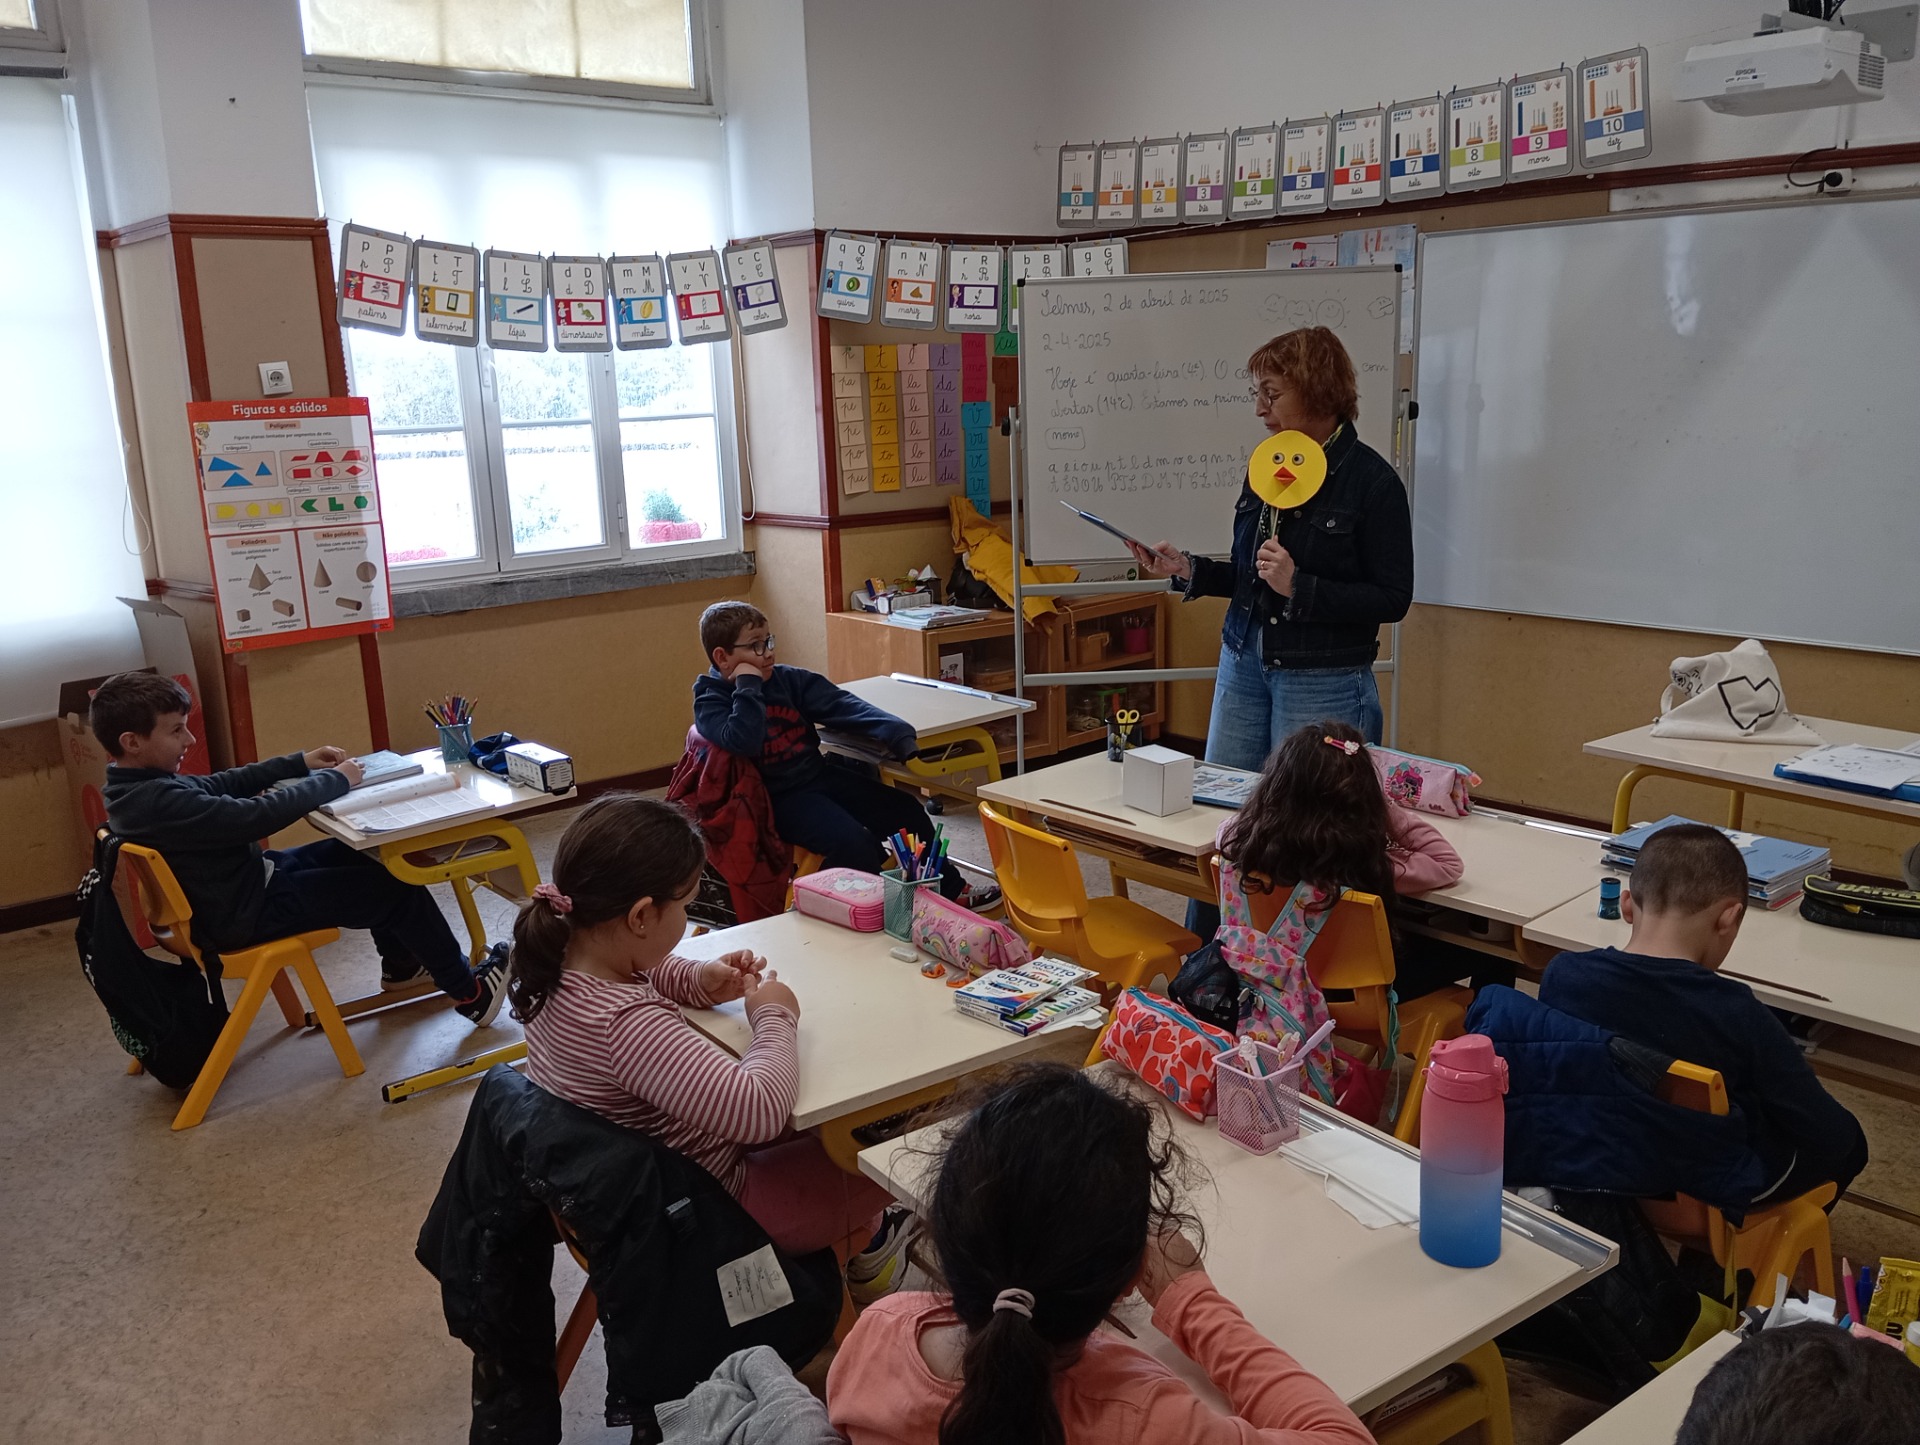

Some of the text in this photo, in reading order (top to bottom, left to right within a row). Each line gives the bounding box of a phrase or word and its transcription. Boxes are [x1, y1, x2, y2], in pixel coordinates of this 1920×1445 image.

[1605, 118, 1622, 133] 10
[1535, 137, 1544, 149] 9
[1470, 149, 1479, 161] 8
[1410, 160, 1418, 172] 7
[1354, 169, 1361, 181] 6
[1250, 182, 1258, 194] 4
[1301, 177, 1308, 188] 5
[1074, 194, 1080, 205] 0
[1115, 194, 1119, 204] 1
[1156, 190, 1162, 201] 2
[1201, 188, 1207, 200] 3
[361, 241, 394, 255] p P
[840, 244, 866, 256] q Q
[432, 253, 462, 267] t T
[738, 252, 760, 265] c C
[901, 251, 927, 261] n N
[963, 256, 988, 265] r R
[1024, 255, 1050, 265] b B
[1085, 248, 1112, 263] g G
[503, 261, 530, 276] l L
[565, 266, 591, 278] d D
[623, 266, 651, 277] m M
[682, 261, 705, 274] v V
[1103, 293, 1112, 312] 2
[1119, 295, 1132, 311] de
[1140, 289, 1175, 308] abril
[1180, 289, 1192, 305] de
[1199, 289, 1229, 304] 2025
[358, 306, 387, 320] patins
[425, 316, 467, 333] telemóvel
[508, 325, 526, 340] lápis
[561, 329, 604, 339] dinossauro
[842, 347, 855, 369] p
[875, 345, 888, 369] t
[908, 345, 915, 365] l
[937, 347, 950, 367] d
[839, 375, 857, 393] pa
[873, 376, 892, 391] ta
[907, 374, 922, 388] la
[935, 374, 957, 392] da
[1045, 366, 1077, 398] Hoje
[1214, 358, 1228, 380] O
[232, 404, 276, 418] Figuras
[289, 402, 328, 414] sólidos
[841, 402, 857, 418] pe
[875, 401, 891, 414] te
[909, 397, 920, 412] le
[937, 399, 953, 413] de
[968, 407, 984, 424] v
[1052, 431, 1080, 441] nome
[845, 448, 865, 467] po
[879, 450, 894, 461] to
[910, 442, 926, 459] lo
[937, 443, 957, 459] do
[880, 474, 897, 485] tu
[911, 466, 927, 482] lu
[939, 466, 958, 480] du
[847, 473, 868, 490] pu
[1032, 961, 1076, 977] GIOTTO
[997, 973, 1039, 988] GIOTTO
